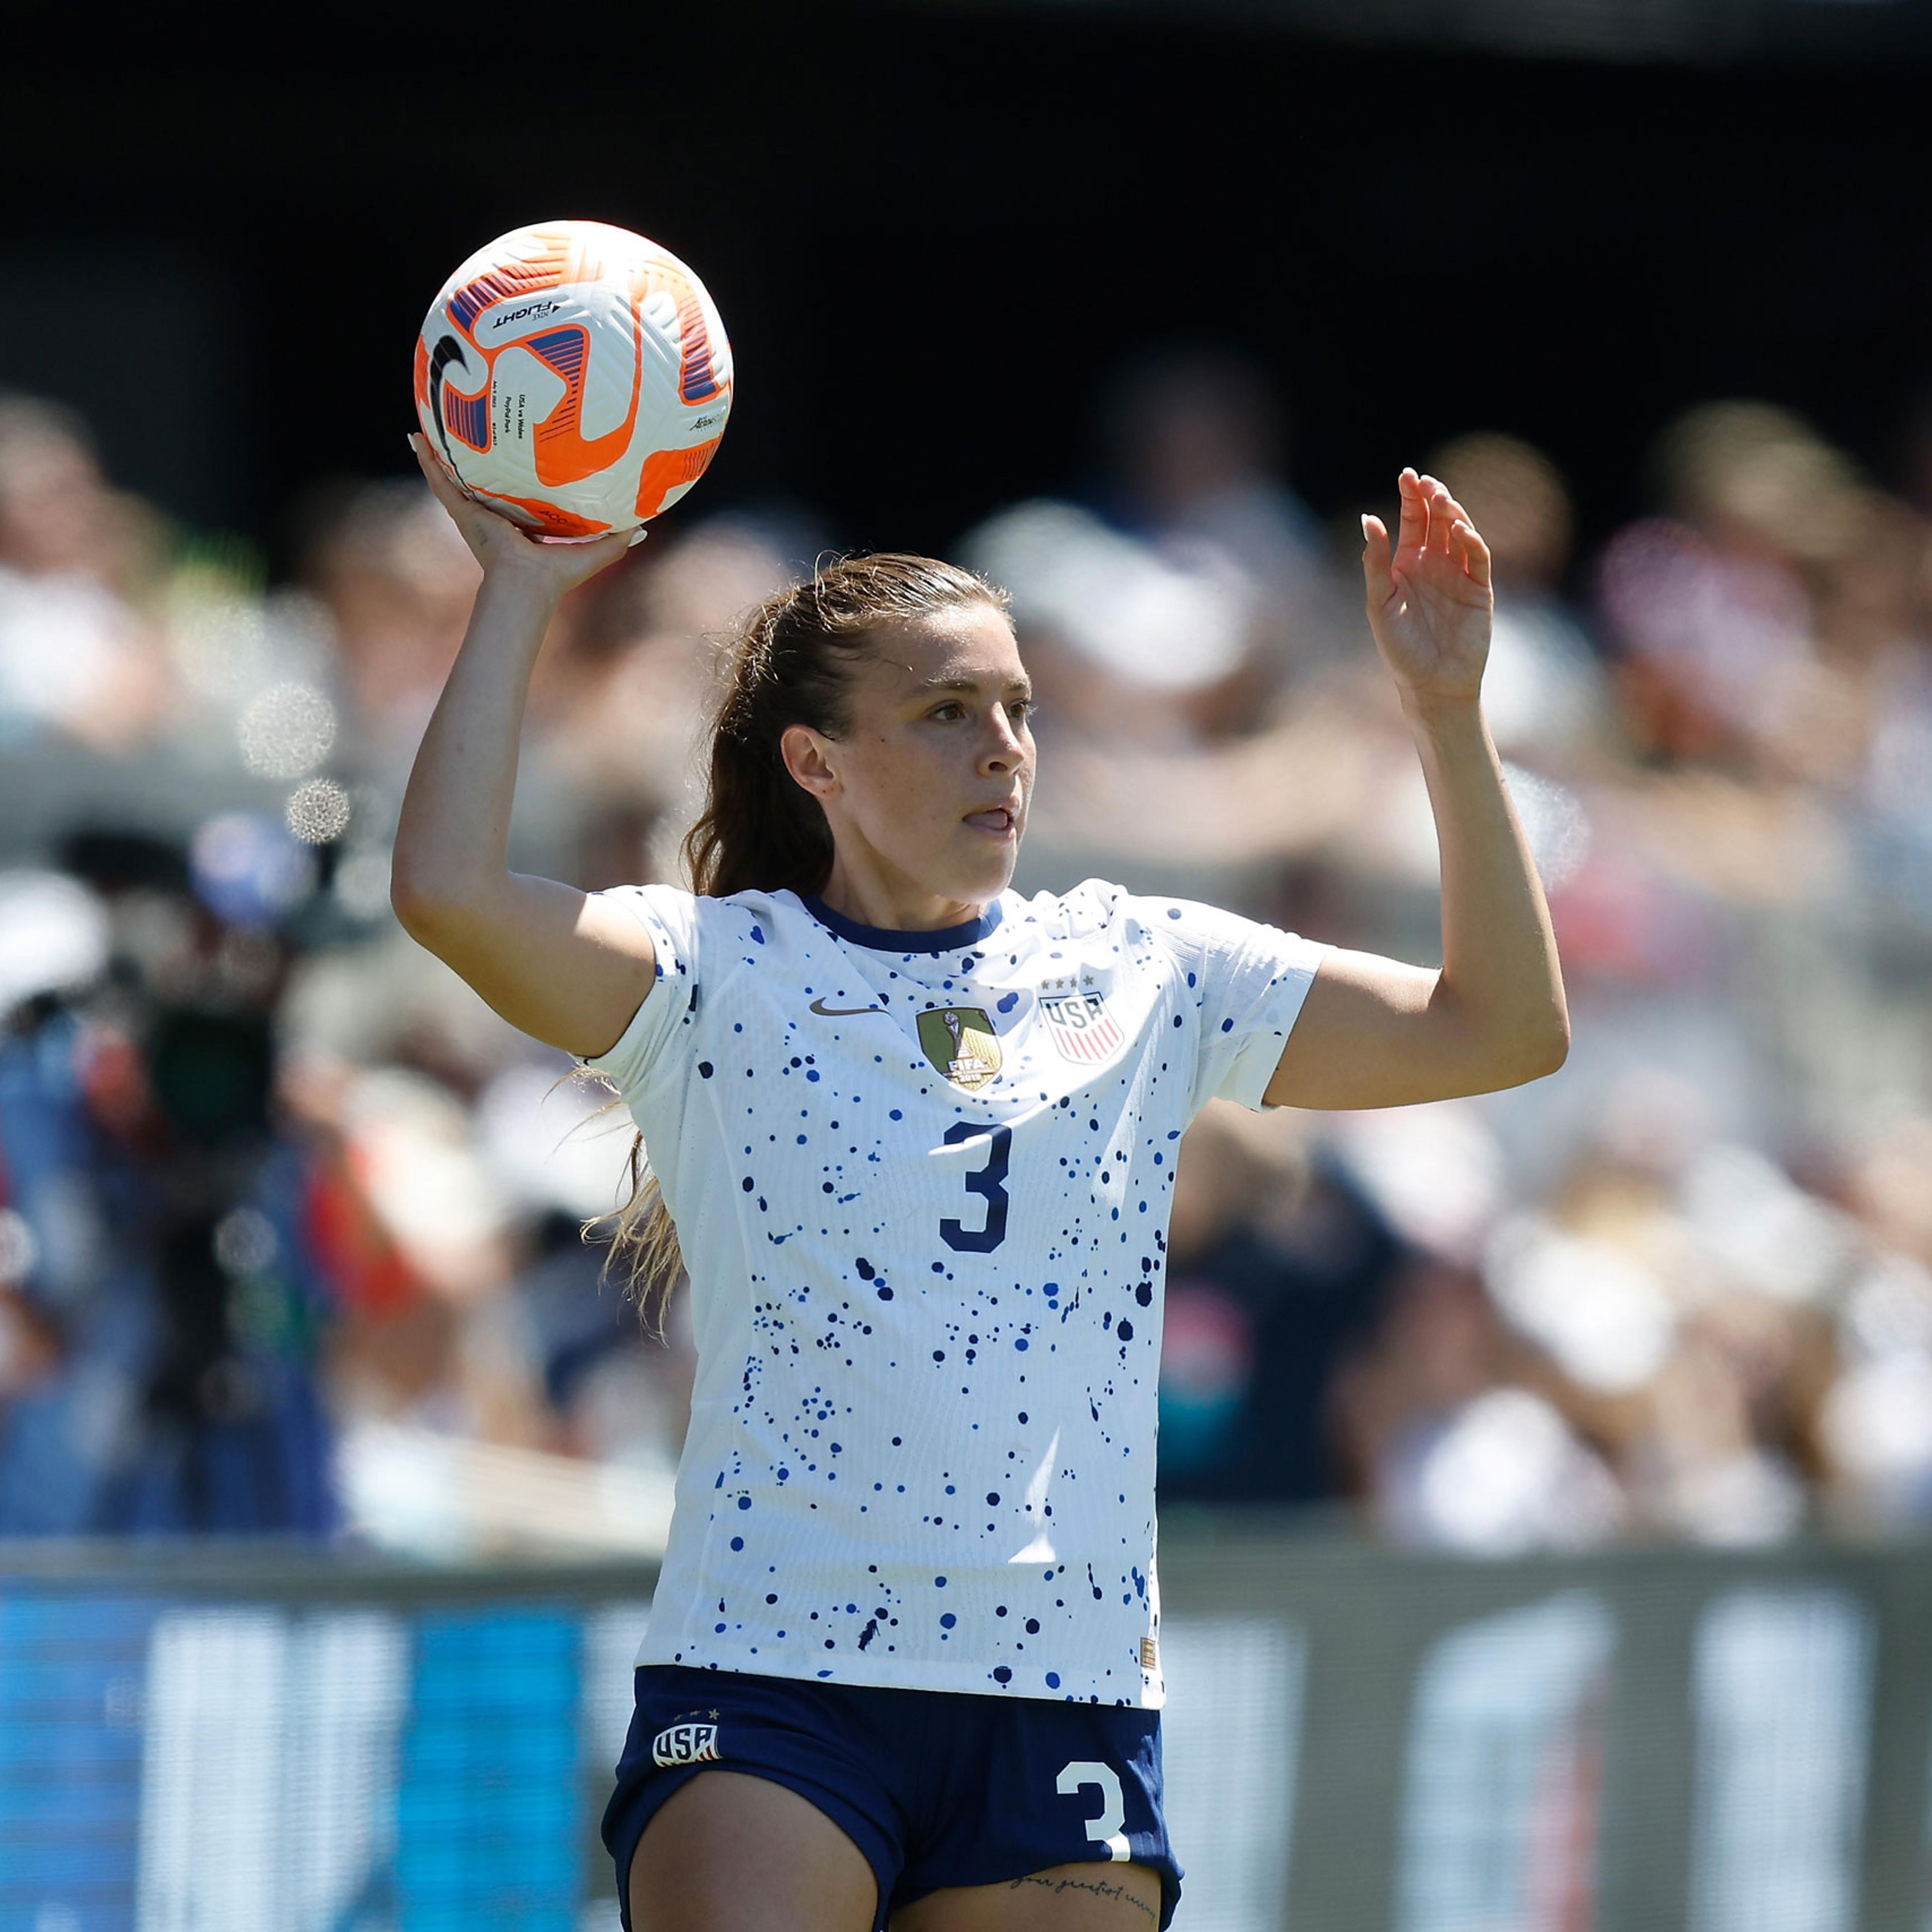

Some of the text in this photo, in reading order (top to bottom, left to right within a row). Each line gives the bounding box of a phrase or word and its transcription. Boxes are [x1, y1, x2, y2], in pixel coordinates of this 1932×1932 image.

[493, 301, 552, 329] FLIGHT
[1045, 997, 1103, 1029] USA
[948, 1058, 985, 1071] FIFA
[939, 1121, 1012, 1253] 3
[656, 1727, 713, 1760] USA
[1056, 1761, 1131, 1862] 3
